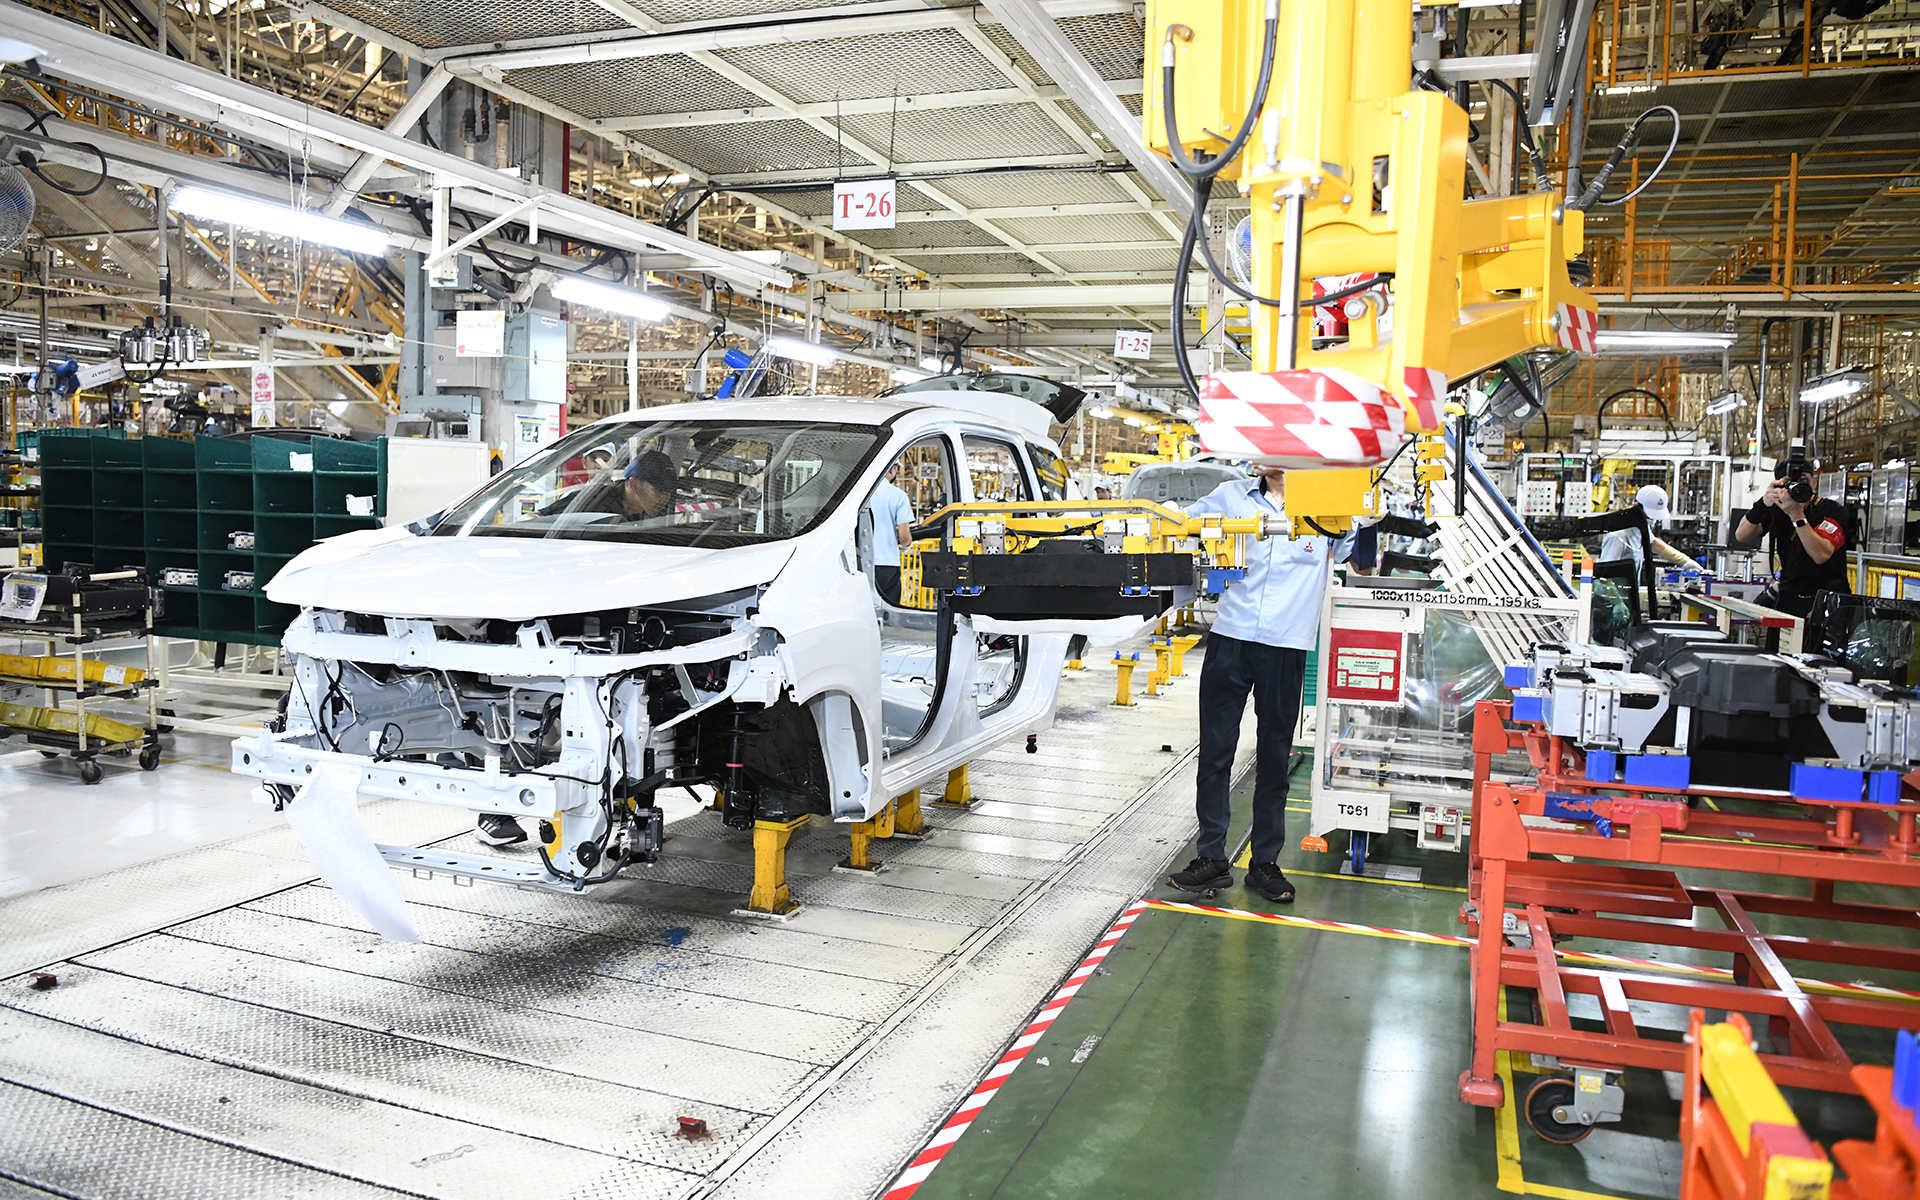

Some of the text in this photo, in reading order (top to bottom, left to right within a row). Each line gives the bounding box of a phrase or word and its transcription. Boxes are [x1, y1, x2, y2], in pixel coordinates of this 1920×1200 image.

[837, 191, 891, 219] T-26
[1118, 336, 1149, 353] T-25
[1484, 429, 1503, 440] -23
[1337, 804, 1368, 817] T061
